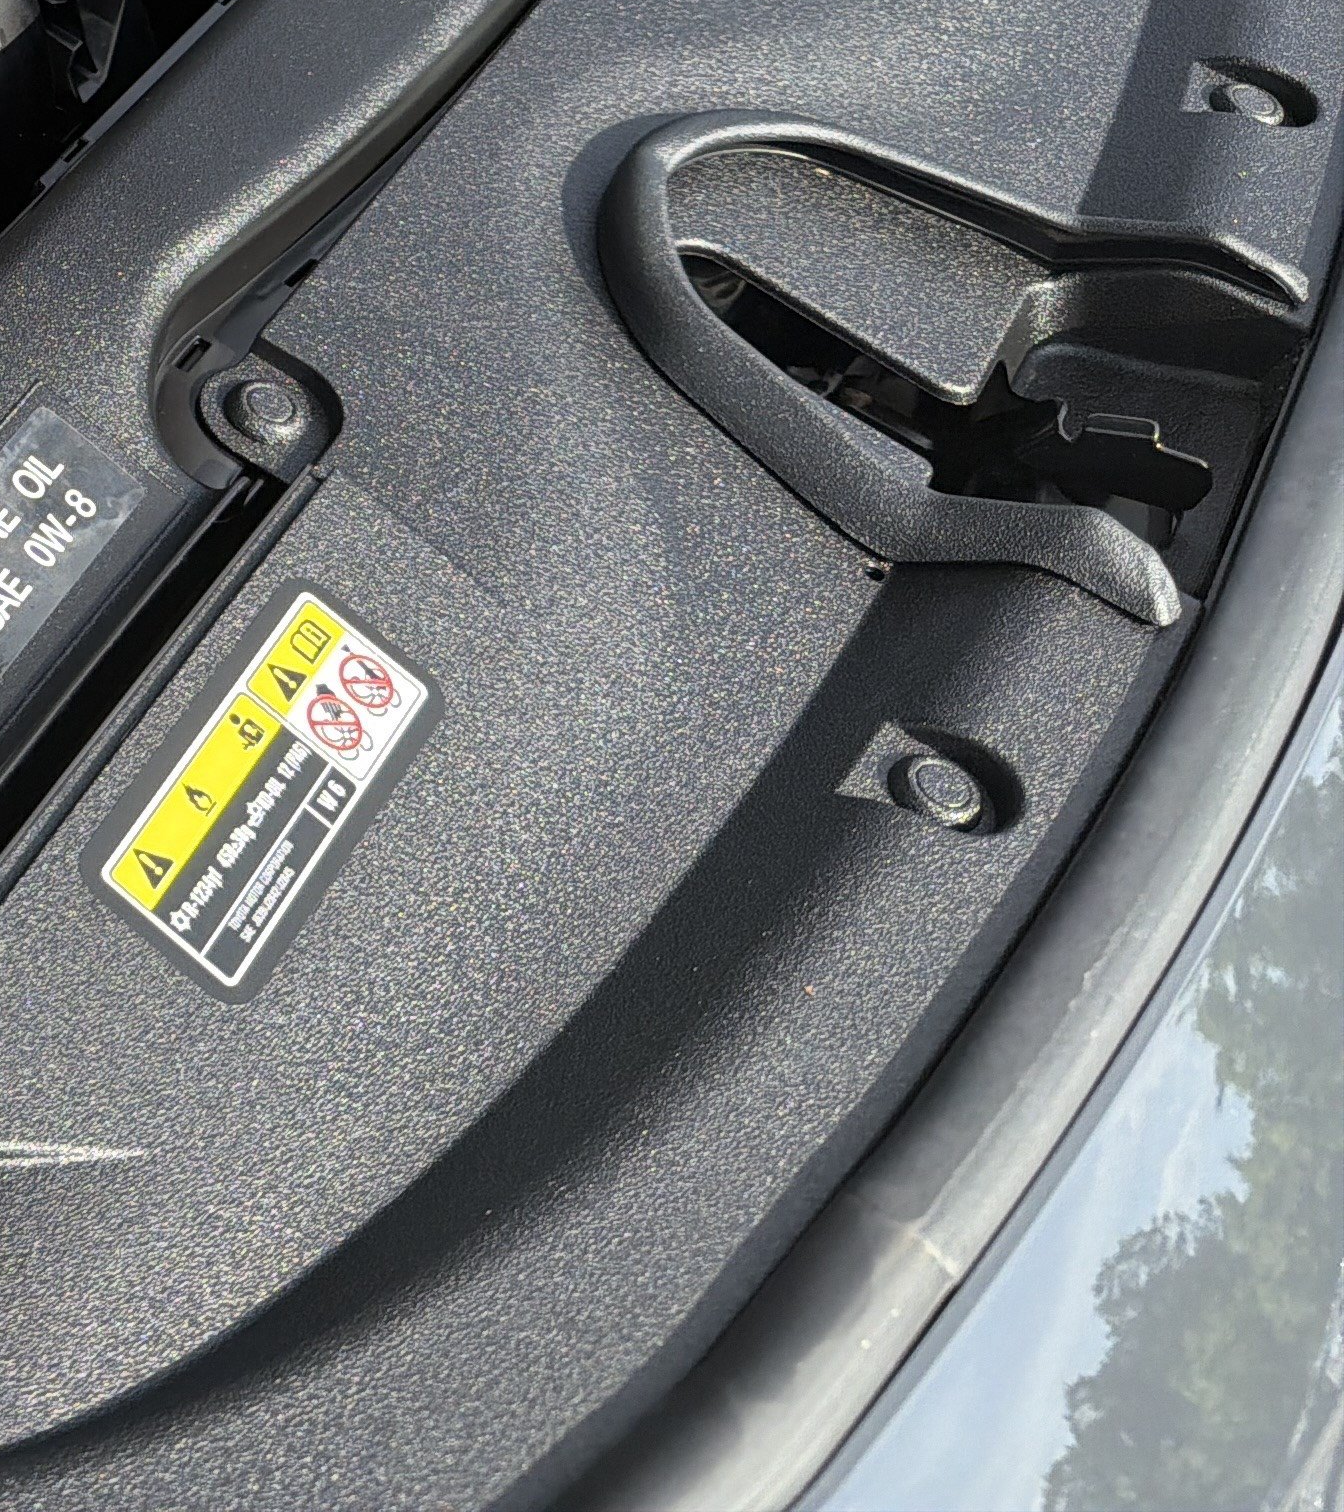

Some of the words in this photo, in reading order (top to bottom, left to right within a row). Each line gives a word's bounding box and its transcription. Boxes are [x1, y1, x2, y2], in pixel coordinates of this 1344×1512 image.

[8, 445, 65, 503] OIL
[20, 485, 100, 571] 0W-8
[275, 760, 296, 780] 12
[227, 902, 251, 931] TOYOTA
[243, 880, 266, 907] MOTOR
[239, 923, 257, 943] SAE
